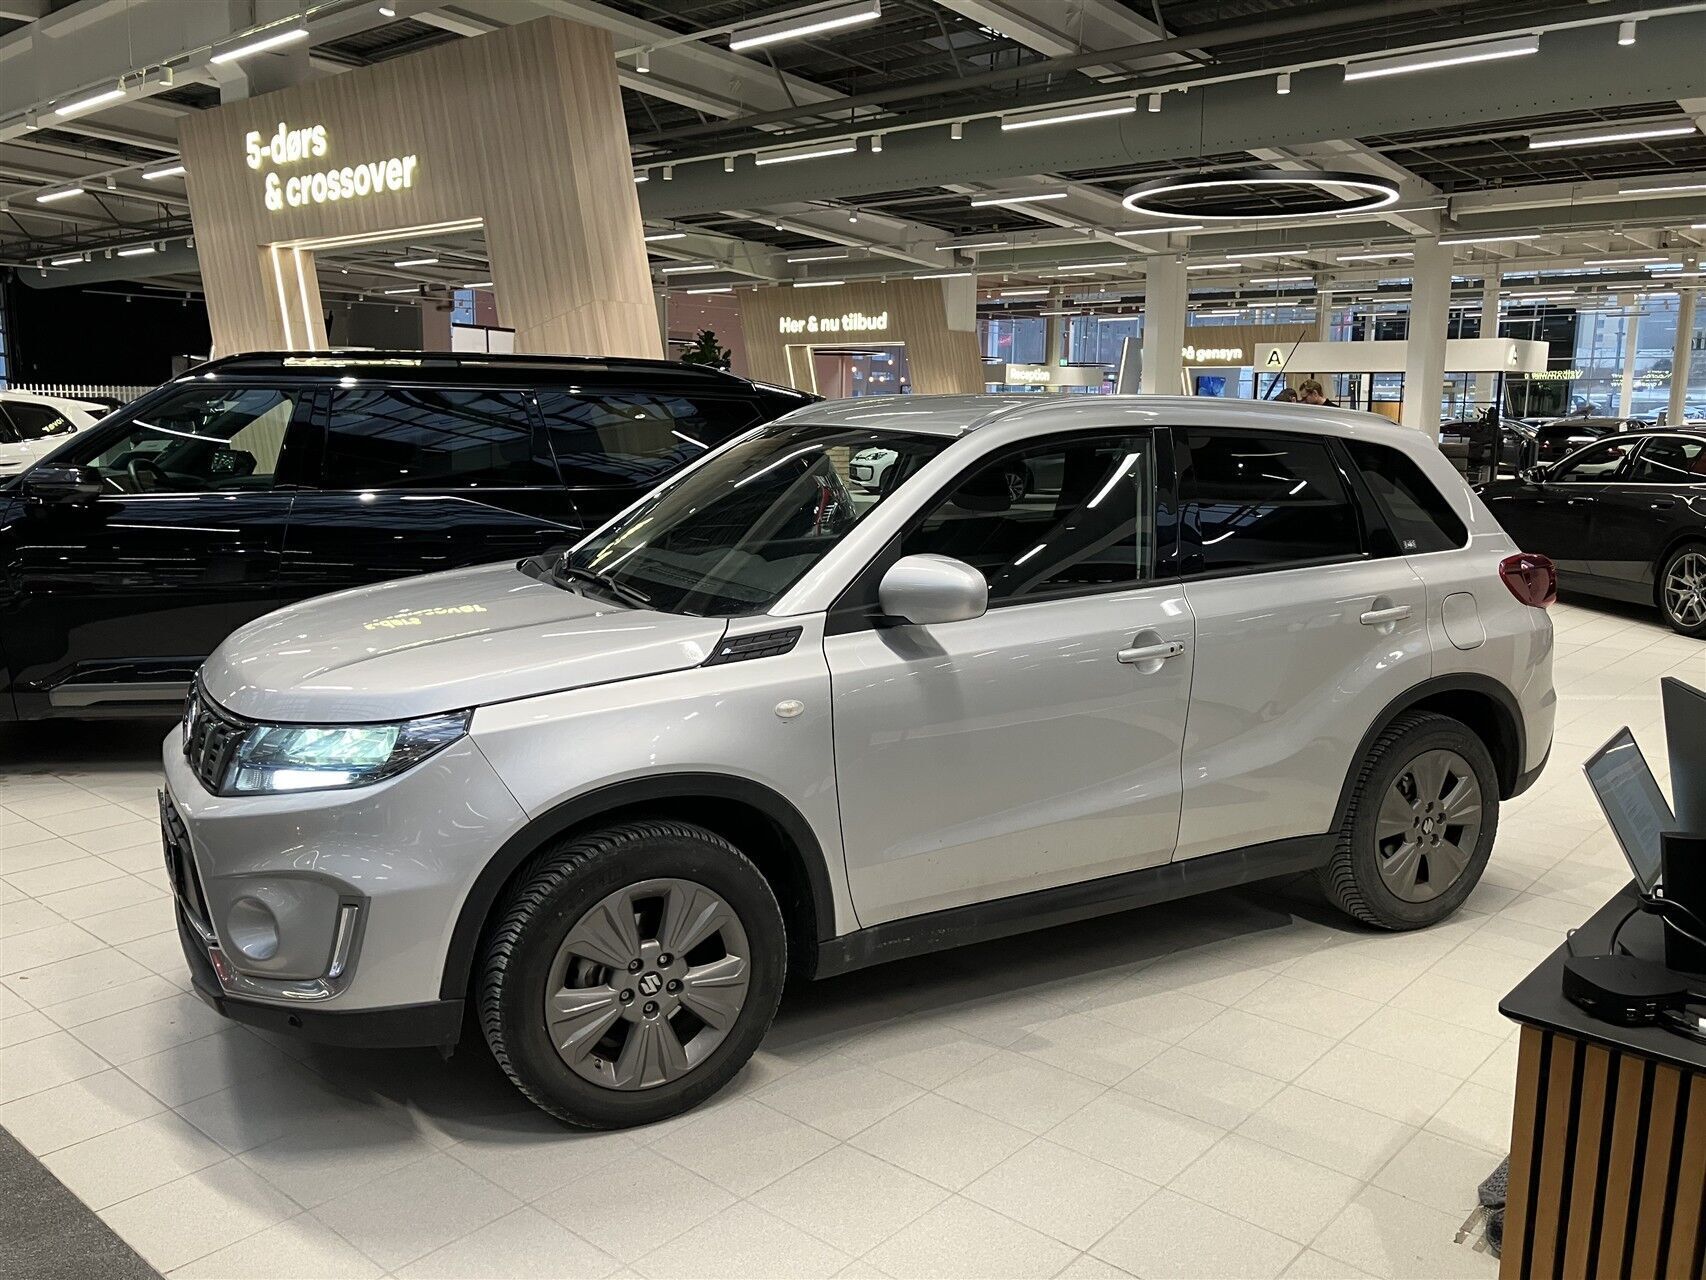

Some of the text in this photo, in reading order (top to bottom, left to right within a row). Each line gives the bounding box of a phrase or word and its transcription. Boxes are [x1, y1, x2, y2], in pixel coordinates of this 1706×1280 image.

[246, 122, 328, 170] 5-dørs
[264, 154, 417, 211] & crossover
[779, 311, 888, 333] Her & nu tilbud
